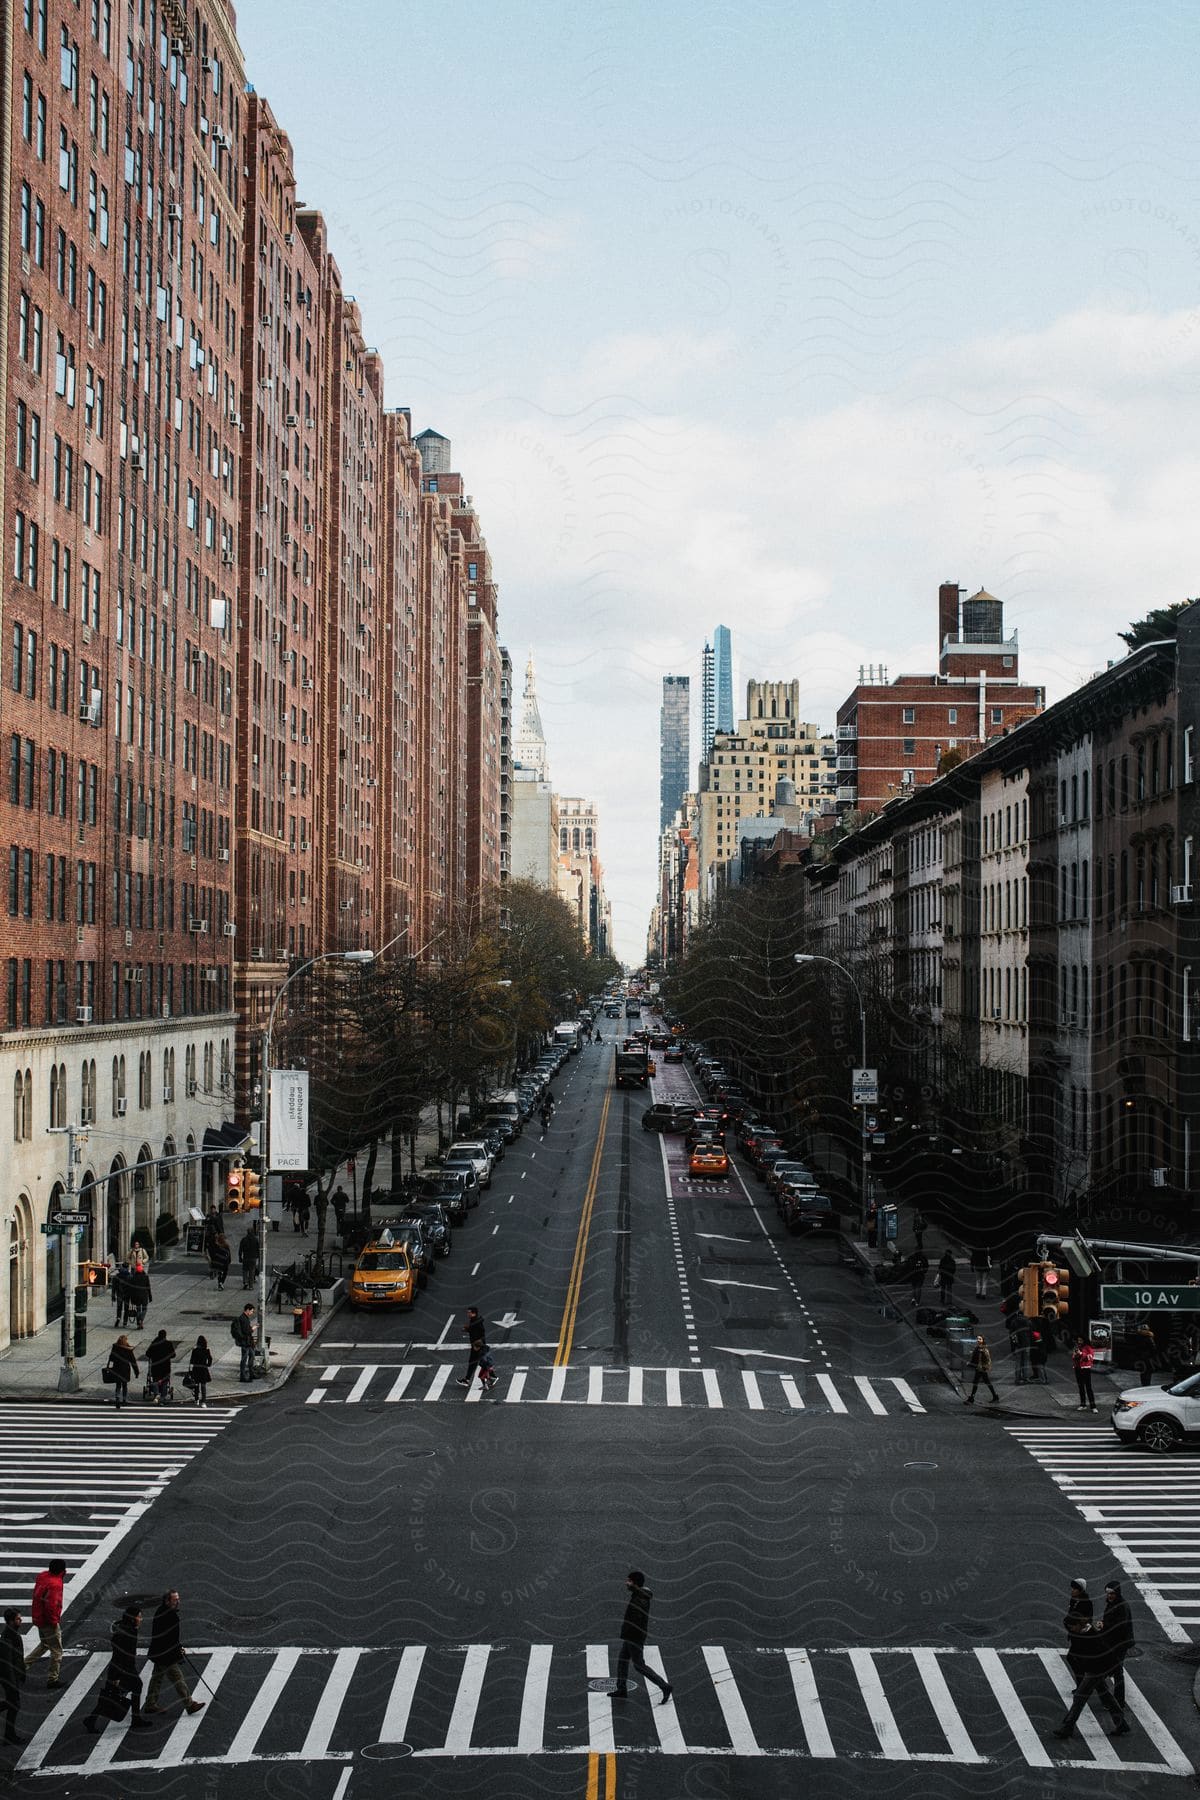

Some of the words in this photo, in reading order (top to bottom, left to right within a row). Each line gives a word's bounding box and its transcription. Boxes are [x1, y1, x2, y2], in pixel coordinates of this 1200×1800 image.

[277, 1158, 302, 1166] PACE
[687, 1186, 731, 1194] BUS
[1134, 1291, 1153, 1305] 10
[1156, 1291, 1180, 1305] Av
